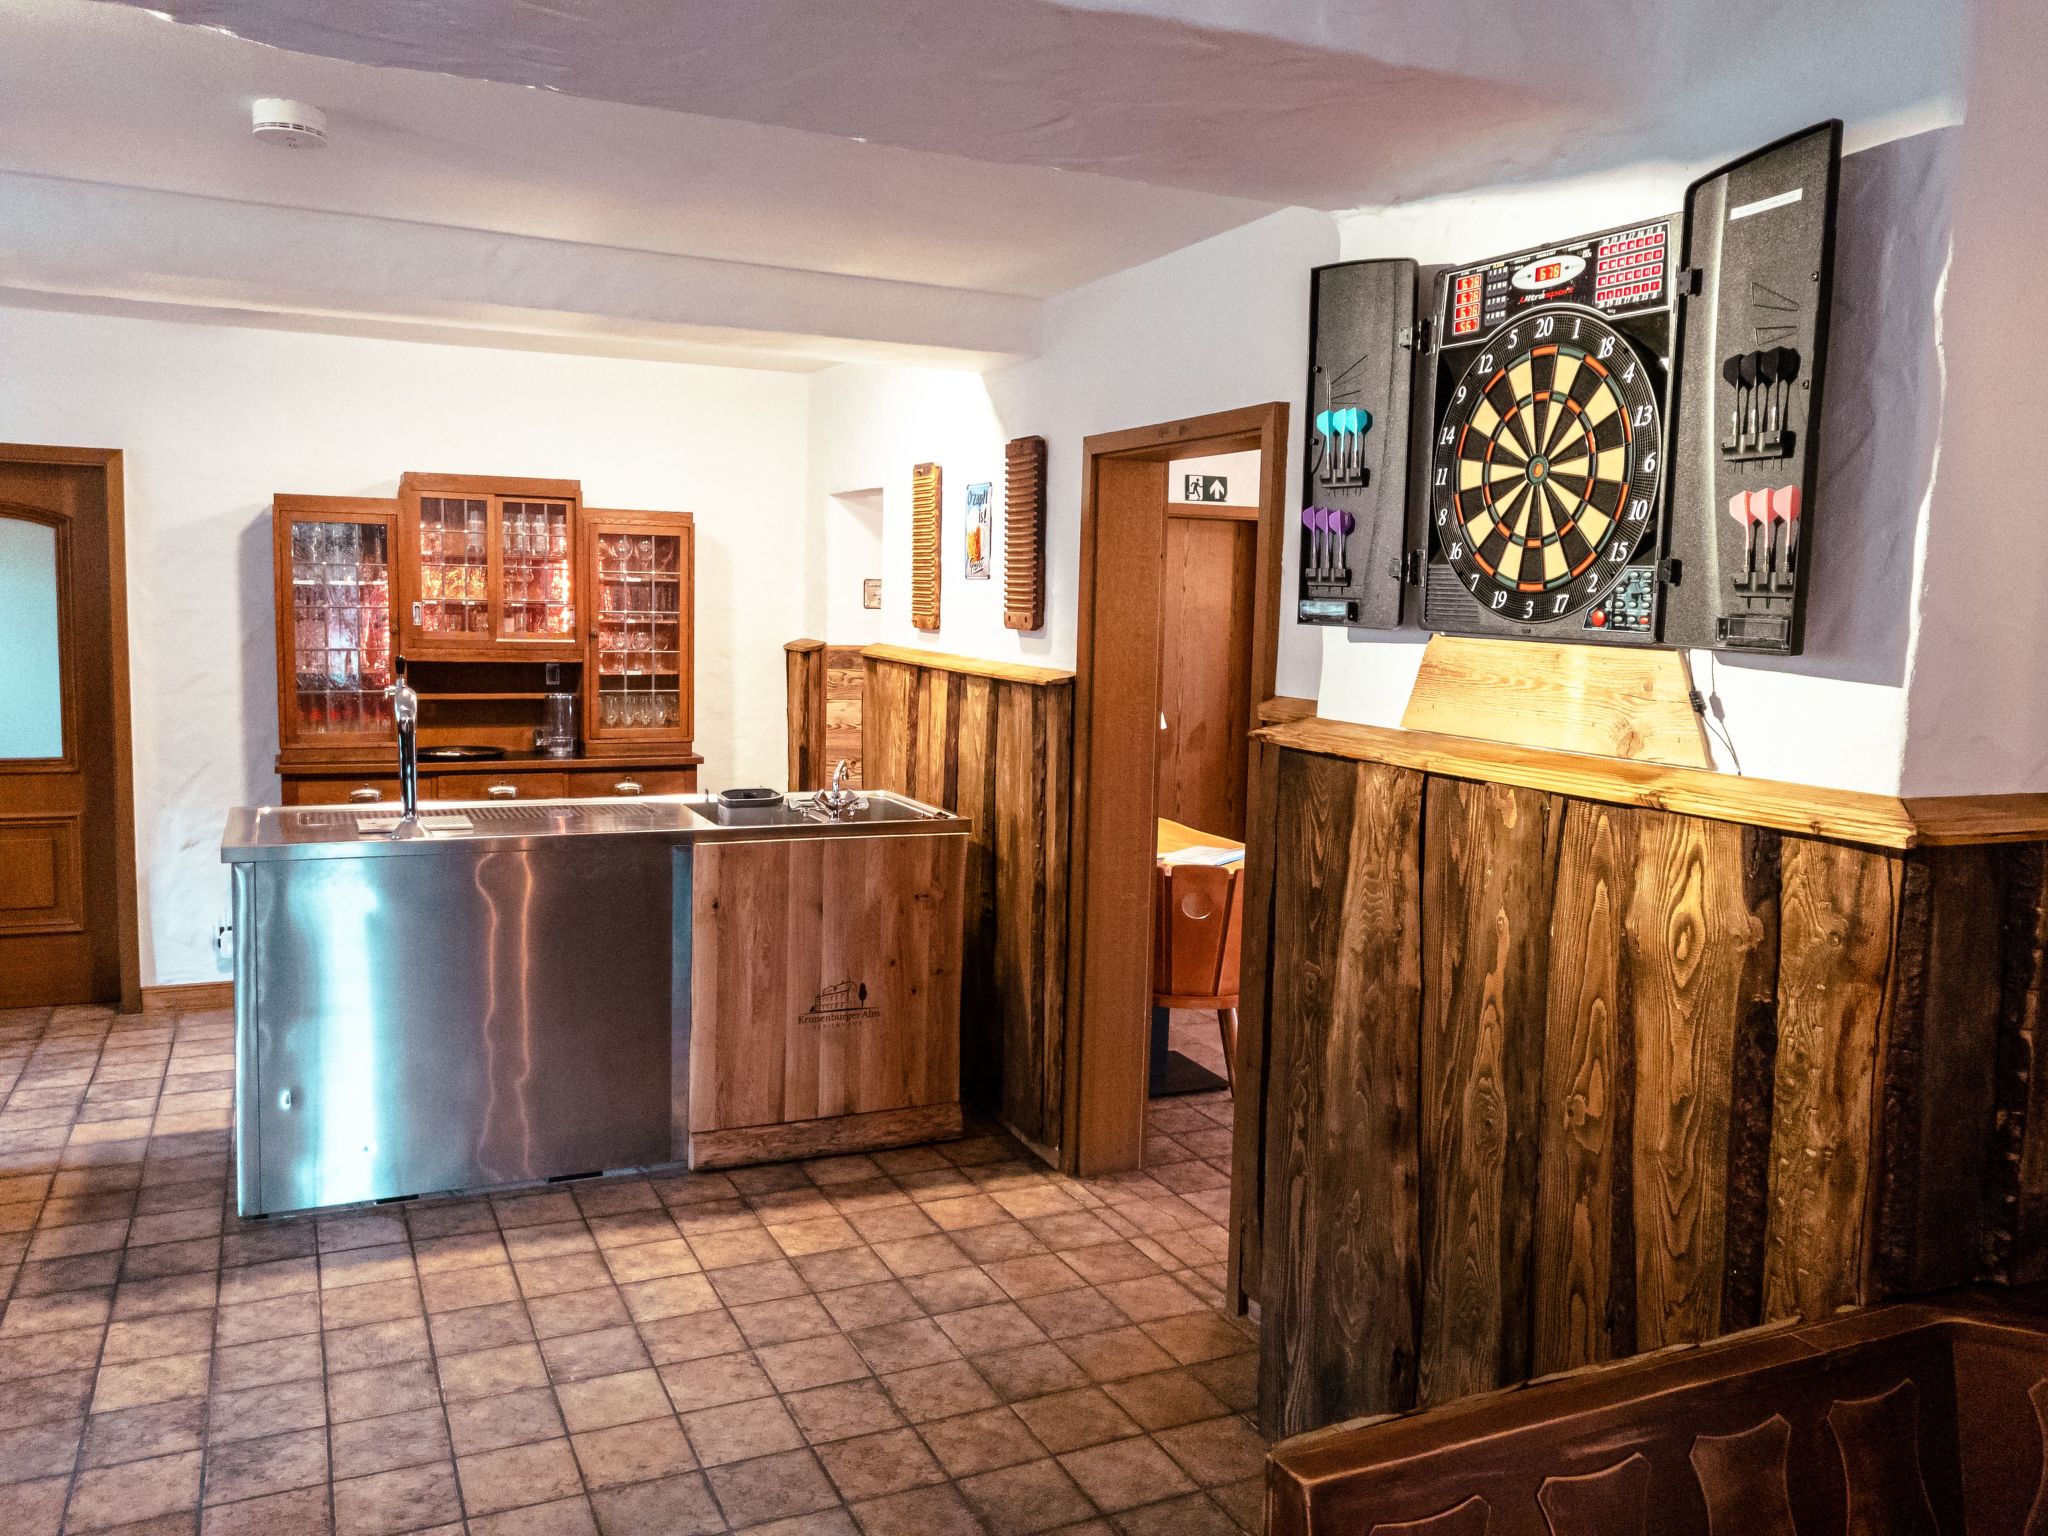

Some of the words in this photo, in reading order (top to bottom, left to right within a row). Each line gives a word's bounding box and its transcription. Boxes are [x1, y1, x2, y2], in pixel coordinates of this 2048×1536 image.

[1534, 318, 1554, 338] 20
[1572, 319, 1580, 339] 1
[1508, 329, 1518, 349] 5
[1598, 337, 1615, 358] 18
[1478, 354, 1493, 374] 12
[1623, 362, 1636, 383] 4
[1457, 386, 1467, 404] 9
[1634, 405, 1653, 426] 13
[1440, 427, 1454, 445] 14
[1644, 452, 1656, 472] 6
[1436, 468, 1448, 485] 11
[978, 508, 986, 523] is!
[1439, 509, 1448, 526] 8
[1628, 500, 1648, 520] 10
[1450, 542, 1462, 560] 16
[1609, 542, 1629, 561] 15
[1470, 574, 1480, 592] 7
[1587, 573, 1598, 593] 2
[1491, 591, 1507, 609] 19
[1524, 601, 1533, 618] 3
[1552, 594, 1569, 613] 17
[798, 1012, 860, 1024] Kronenburger
[862, 1010, 881, 1018] Alm
